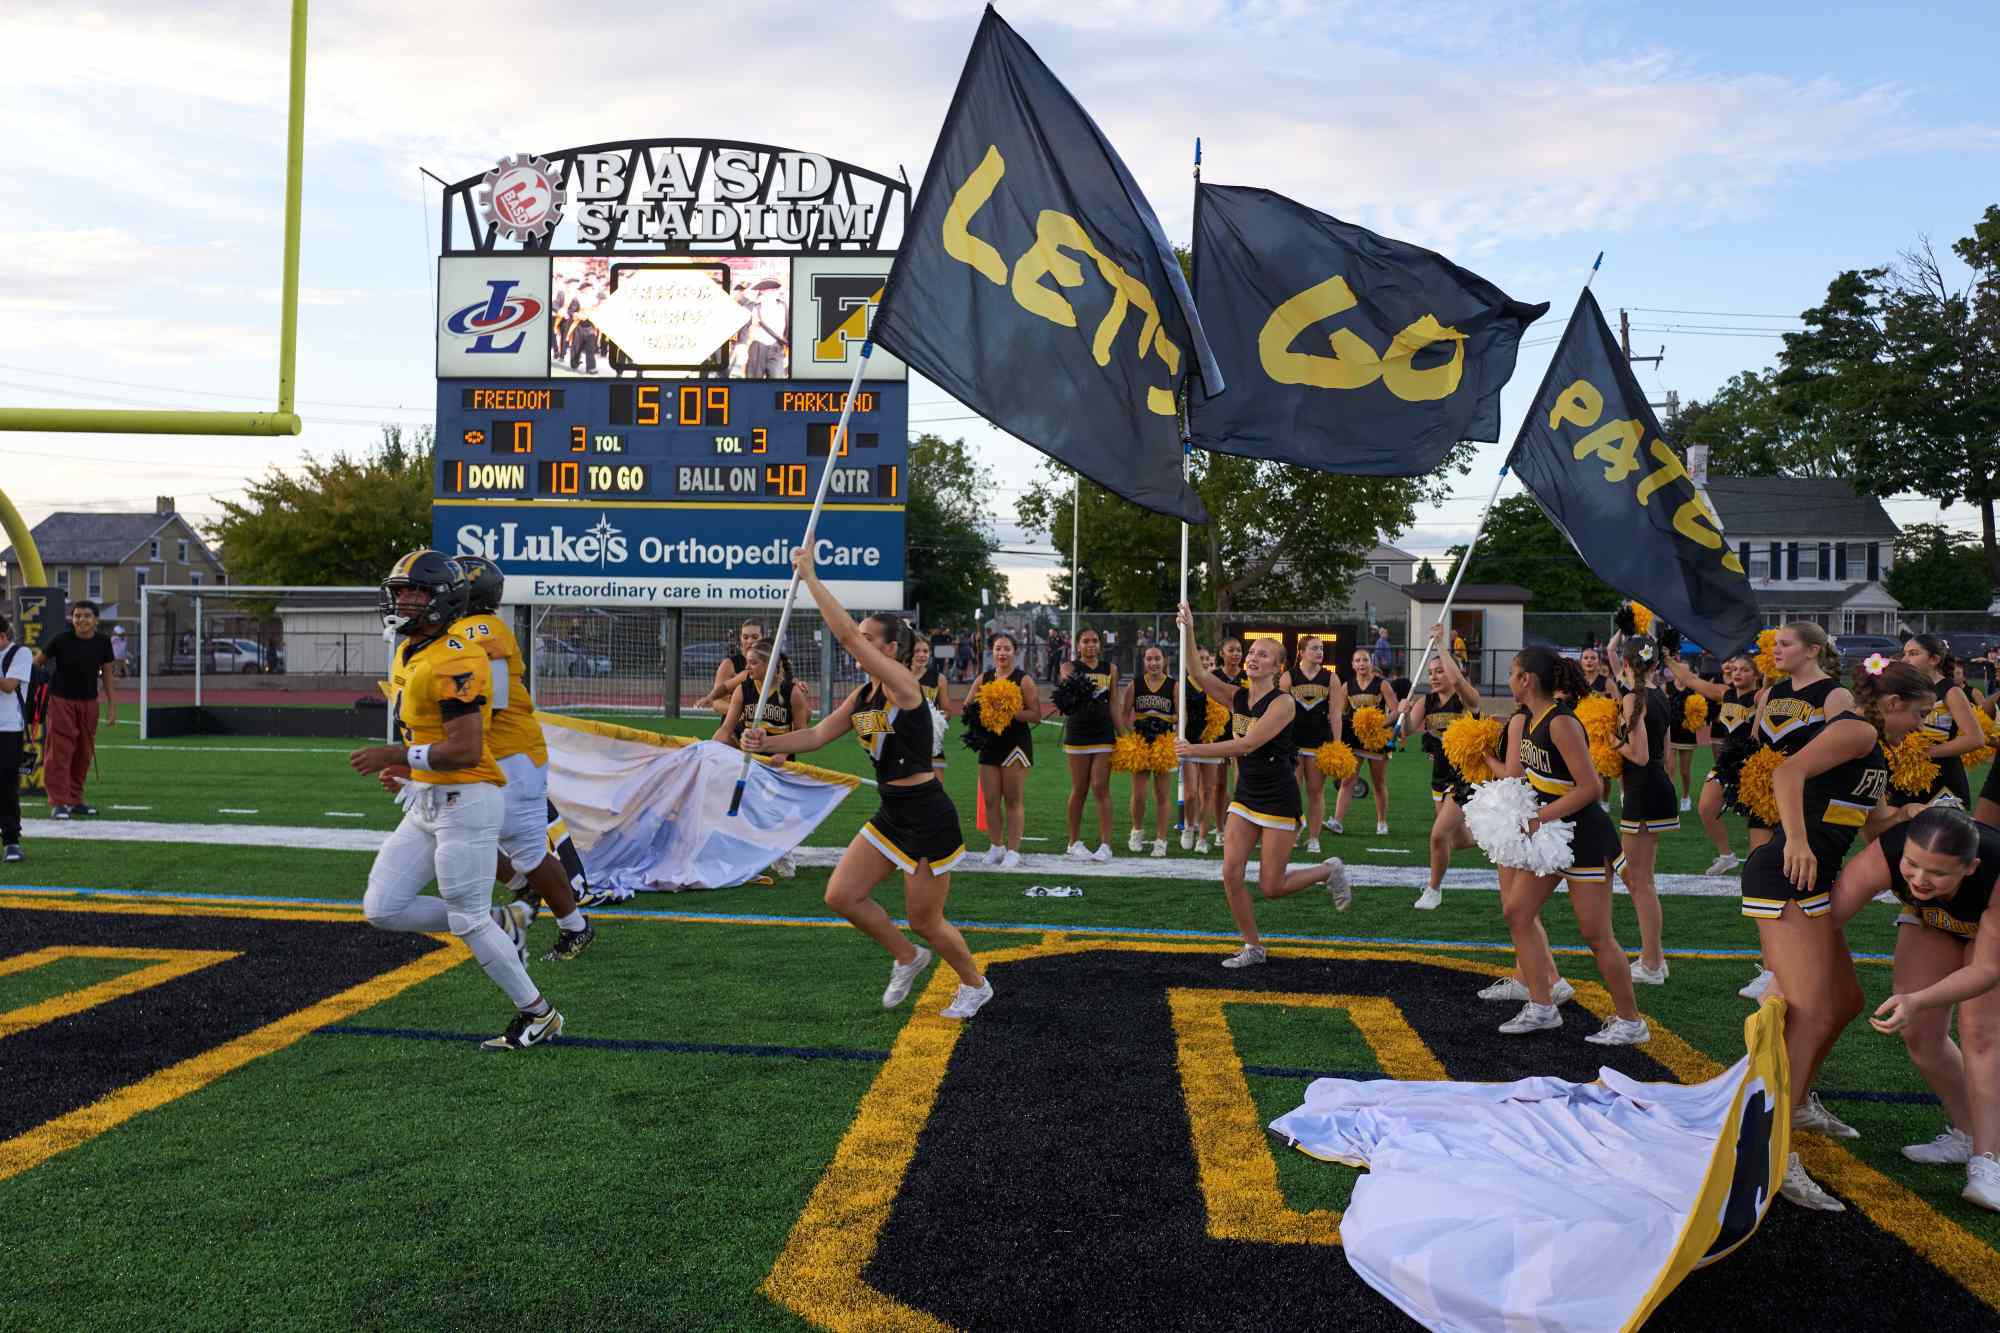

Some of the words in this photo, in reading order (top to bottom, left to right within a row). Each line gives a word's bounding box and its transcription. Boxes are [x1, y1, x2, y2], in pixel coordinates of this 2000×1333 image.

[577, 152, 836, 203] BASD
[502, 188, 530, 225] BASD
[577, 203, 873, 243] STADIUM
[1258, 274, 1470, 402] GO
[473, 390, 551, 410] FREEDOM
[637, 385, 729, 425] 5:09
[783, 392, 872, 413] PARKLAND
[514, 422, 532, 453] 0
[572, 426, 587, 452] 3
[594, 435, 622, 452] TOL
[715, 436, 742, 453] TOL
[751, 428, 767, 454] 3
[468, 464, 525, 490] DOWN
[551, 462, 579, 494] 10
[588, 466, 612, 491] TO
[616, 466, 644, 491] GO
[679, 467, 724, 492] BALL
[729, 467, 756, 493] ON
[766, 464, 807, 497] 40
[830, 469, 869, 495] QTR
[814, 539, 880, 566] Care
[534, 580, 657, 601] Extraordinary
[663, 585, 701, 598] care
[706, 583, 722, 599] in
